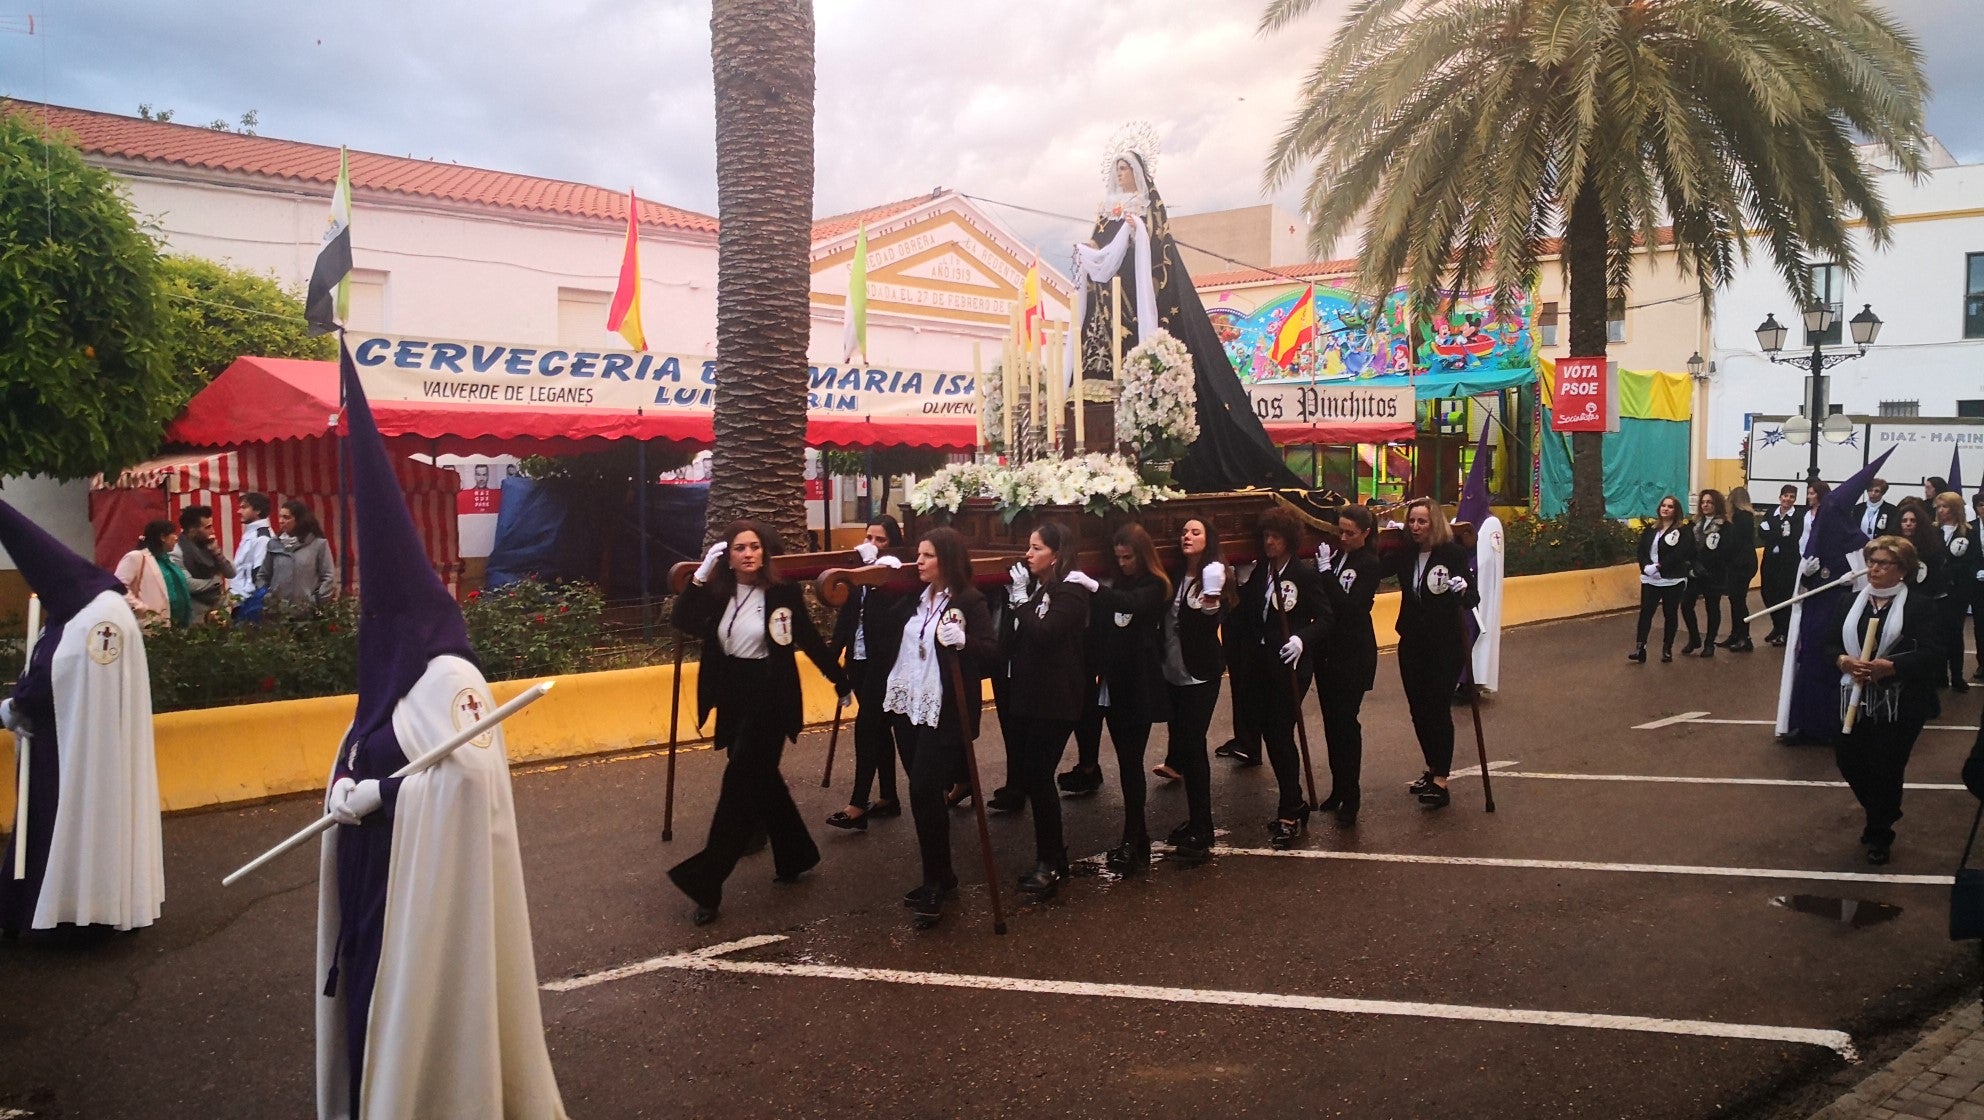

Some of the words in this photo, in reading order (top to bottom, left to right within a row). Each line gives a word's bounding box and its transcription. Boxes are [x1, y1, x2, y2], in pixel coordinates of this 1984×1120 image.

[898, 234, 936, 257] OBRERA
[952, 267, 971, 282] 1919
[981, 249, 1026, 288] REDENTOR
[866, 283, 897, 301] NDADA
[900, 288, 913, 302] EL
[917, 290, 929, 303] 27
[932, 292, 944, 306] DE
[948, 294, 991, 312] FEBRERO
[993, 300, 1004, 313] DE
[355, 338, 681, 383] CERVECERIA
[805, 366, 922, 395] MARIA
[1563, 365, 1598, 378] VOTA
[423, 380, 500, 401] VALVERDE
[504, 384, 524, 402] DE
[529, 386, 594, 404] LEGANES
[653, 385, 715, 407] LUI
[1560, 382, 1599, 396] PSOE
[922, 401, 977, 415] OLIVEN
[1297, 386, 1398, 423] Pinchitos
[1880, 431, 1917, 442] DIAZ
